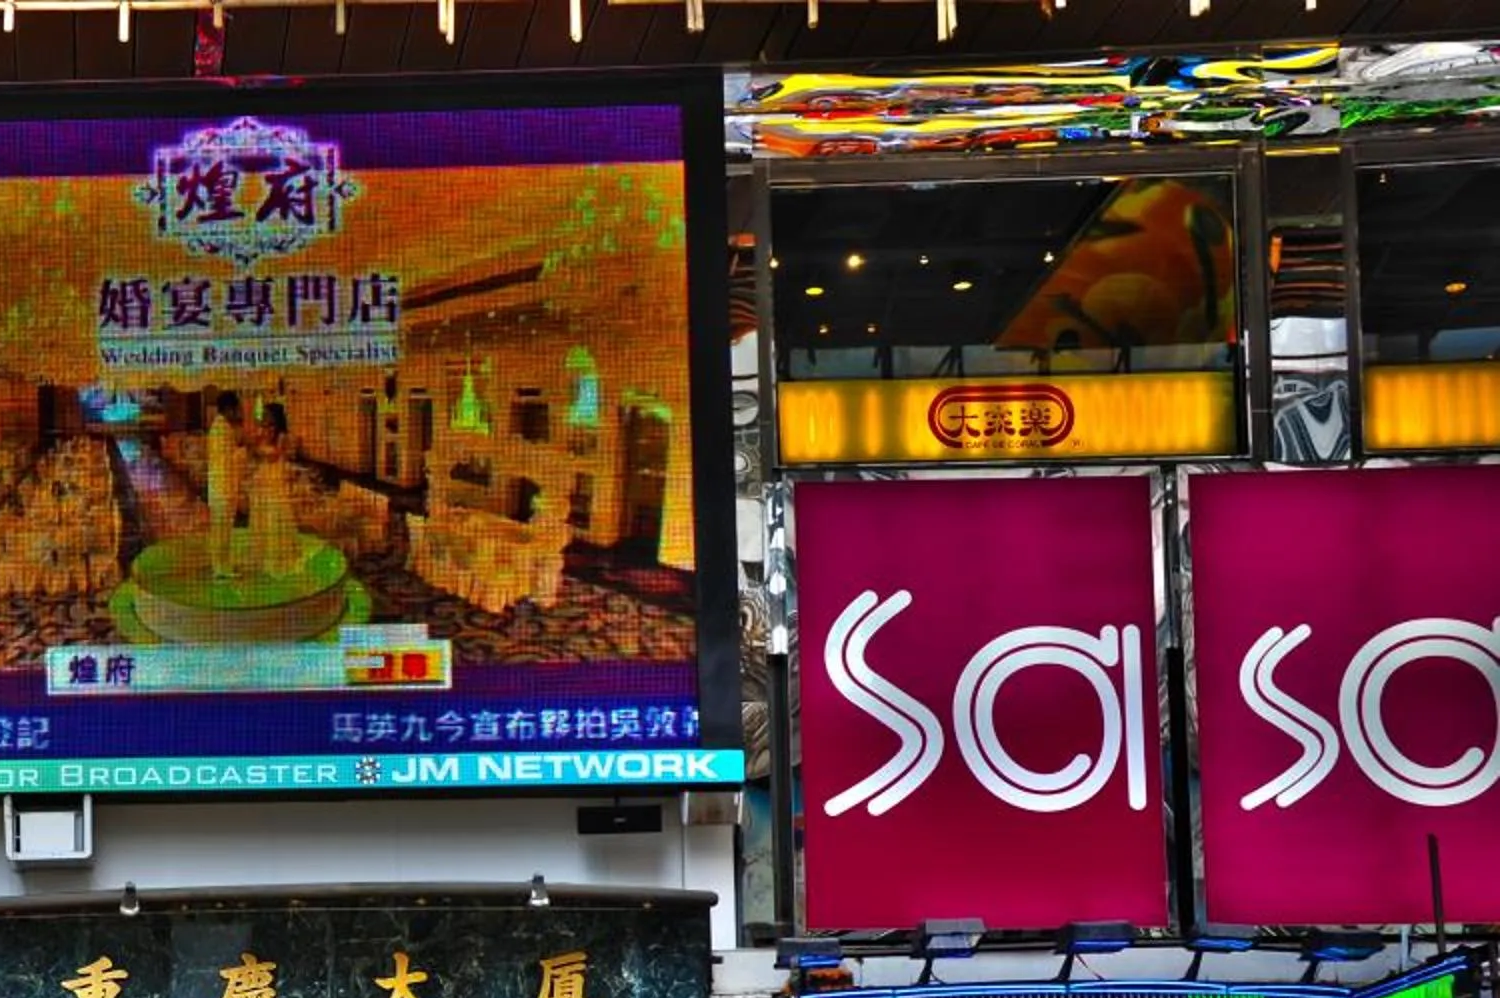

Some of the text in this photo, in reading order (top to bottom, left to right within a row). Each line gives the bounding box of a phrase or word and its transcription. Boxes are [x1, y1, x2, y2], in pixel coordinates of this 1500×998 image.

[176, 158, 319, 226] 煌府
[100, 273, 399, 329] 婚宴專門店
[100, 341, 398, 366] Wedding Banquet Specialist
[68, 654, 136, 685] 煌府
[60, 763, 339, 787] BROADCASTER
[392, 756, 461, 784] JM
[478, 751, 720, 782] NETWORK
